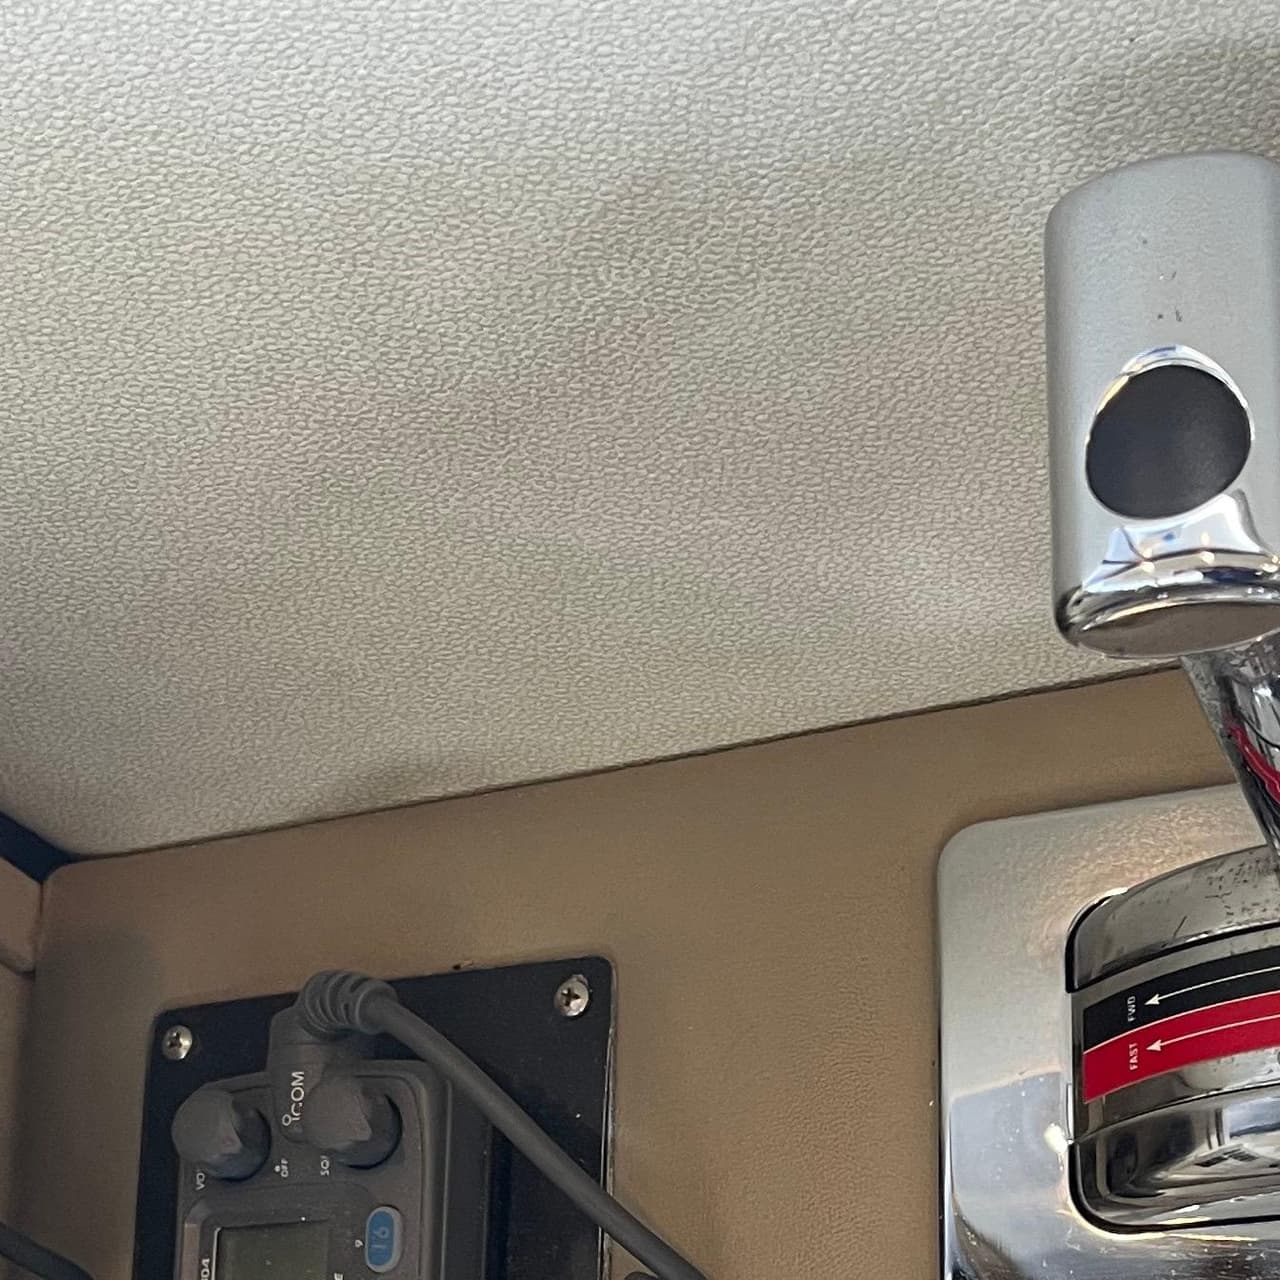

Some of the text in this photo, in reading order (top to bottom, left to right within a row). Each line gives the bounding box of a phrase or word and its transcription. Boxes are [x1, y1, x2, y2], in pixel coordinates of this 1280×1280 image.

[1127, 995, 1136, 1022] FWD
[1129, 1042, 1138, 1071] FAST
[194, 1166, 206, 1190] VO
[281, 1159, 289, 1178] OFF
[355, 1239, 364, 1248] 9
[370, 1226, 389, 1250] 16
